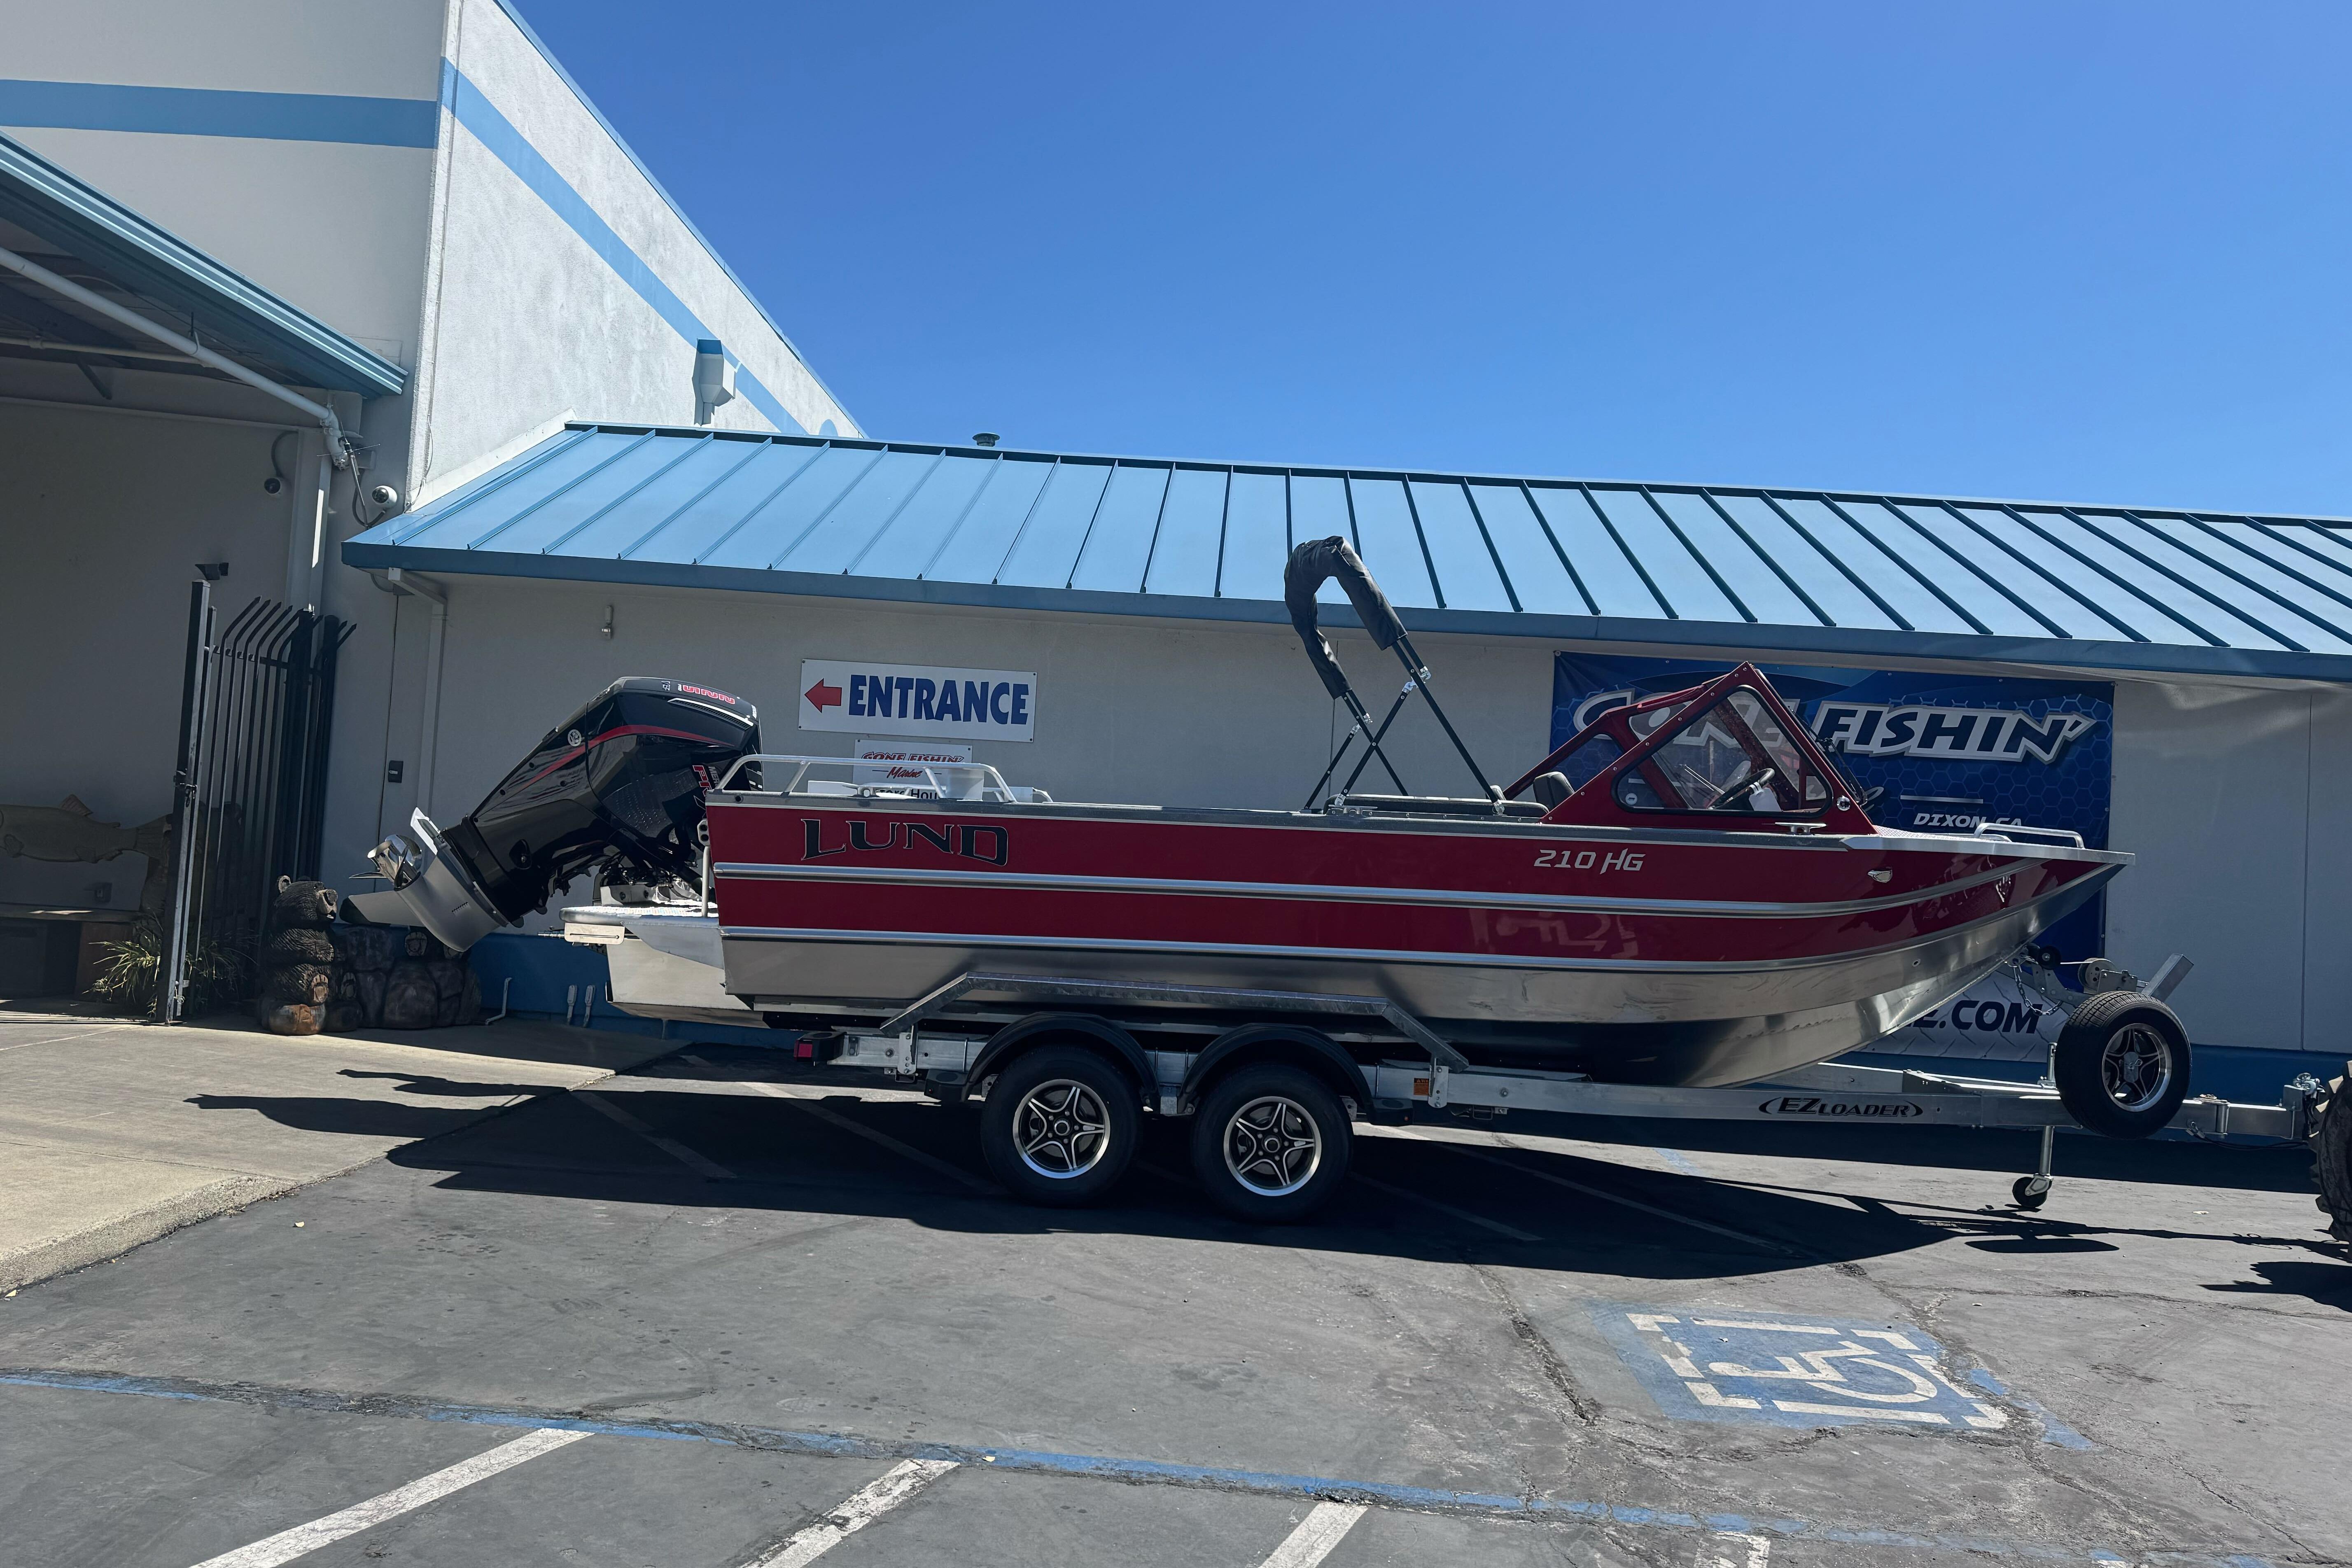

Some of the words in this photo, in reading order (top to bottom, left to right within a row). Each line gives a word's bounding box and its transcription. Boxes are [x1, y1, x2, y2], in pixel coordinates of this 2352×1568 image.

[683, 685, 735, 705] 225
[848, 674, 1029, 725] ENTRANCE
[1807, 701, 2094, 763] FISHIN'
[800, 818, 1008, 867] LUND
[1533, 849, 1597, 869] 210
[1599, 848, 1646, 875] HG
